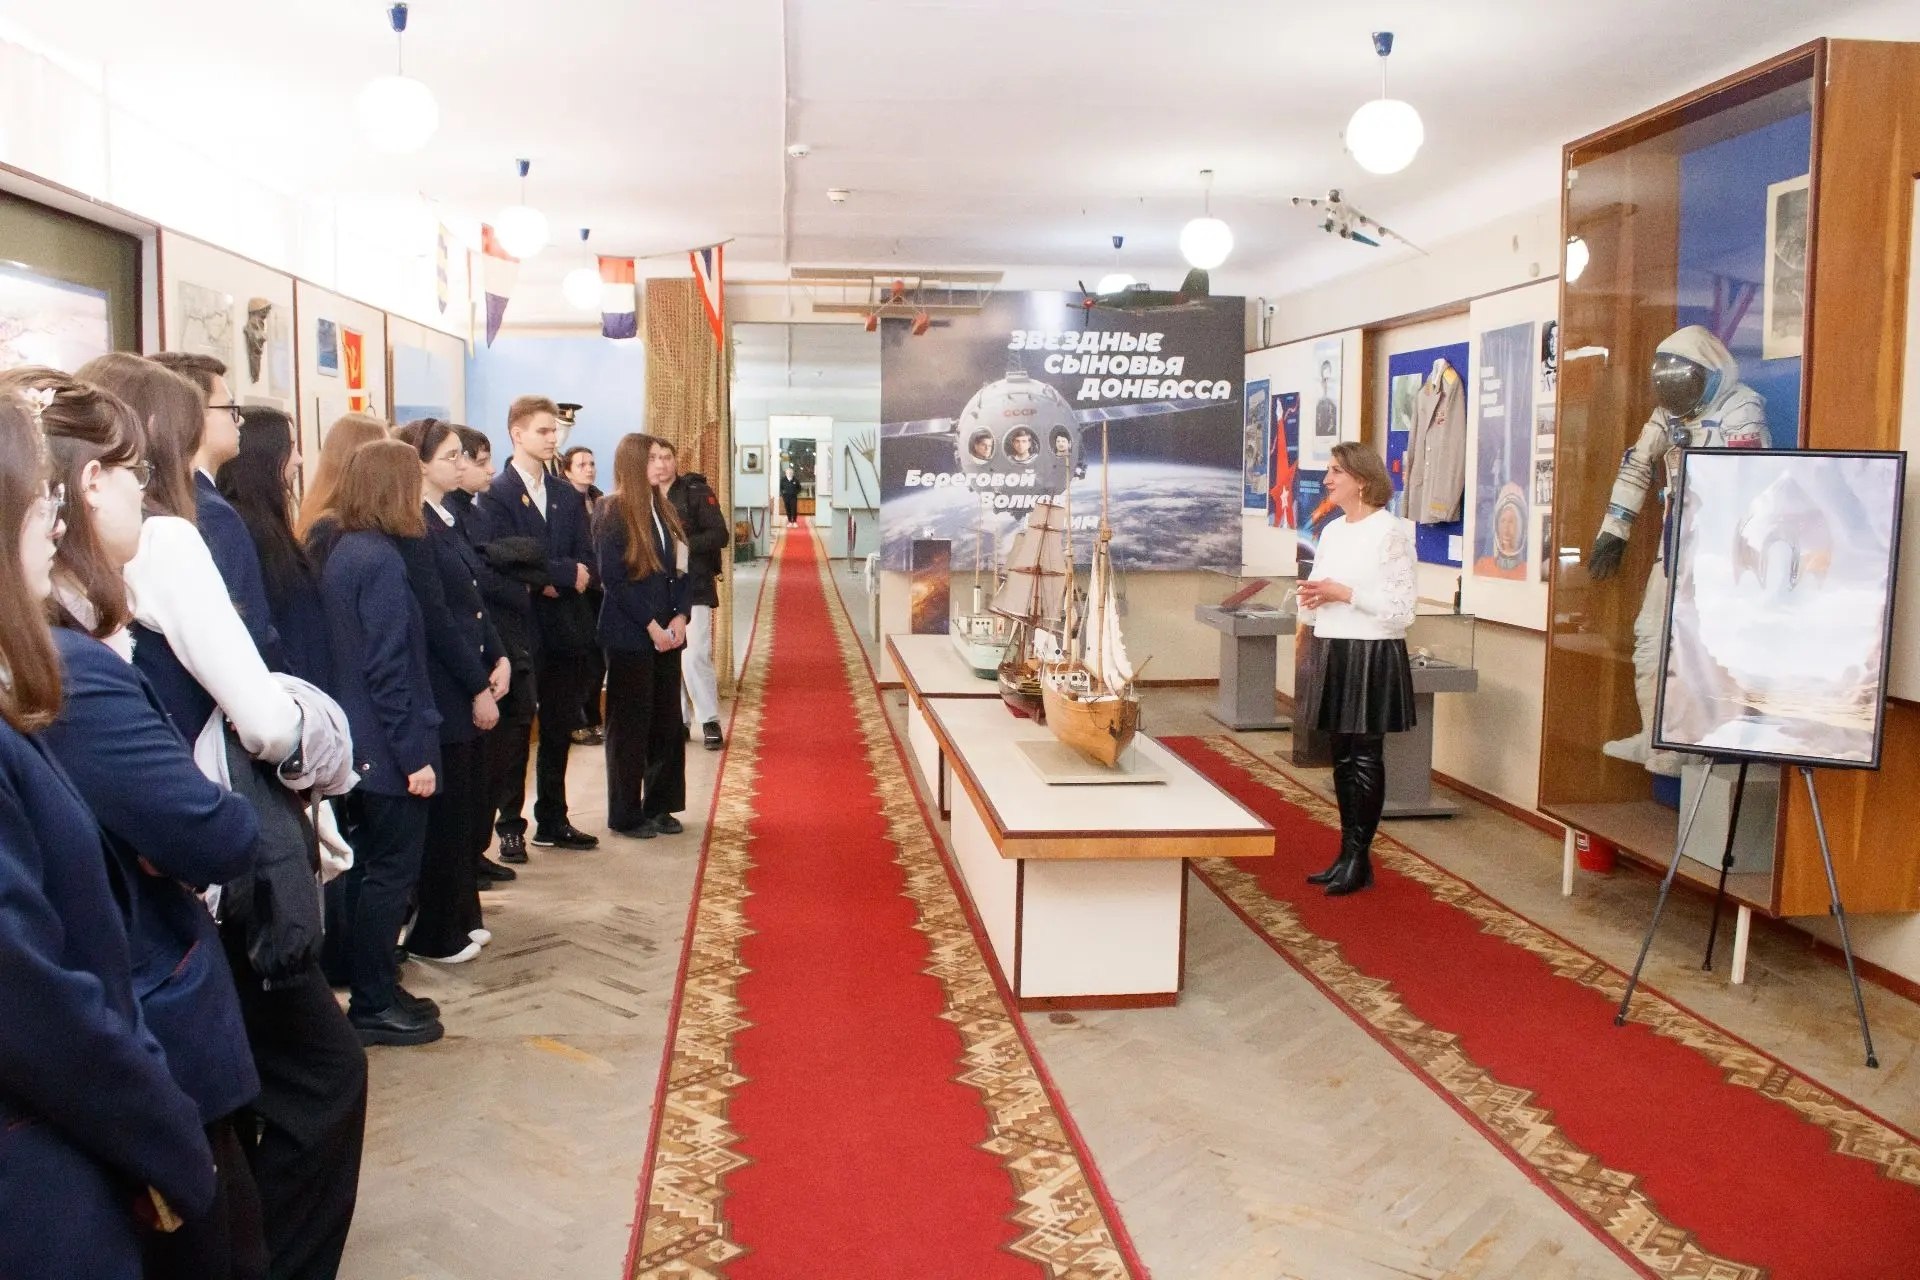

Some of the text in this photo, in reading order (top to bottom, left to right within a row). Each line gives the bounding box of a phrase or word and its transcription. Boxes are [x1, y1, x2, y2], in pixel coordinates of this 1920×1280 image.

[1007, 330, 1165, 353] ЗВЕЗДНЫЕ
[1044, 354, 1185, 375] СЫНОВЬЯ
[1076, 378, 1232, 400] ДОНБАССА
[904, 469, 1036, 489] Береговой
